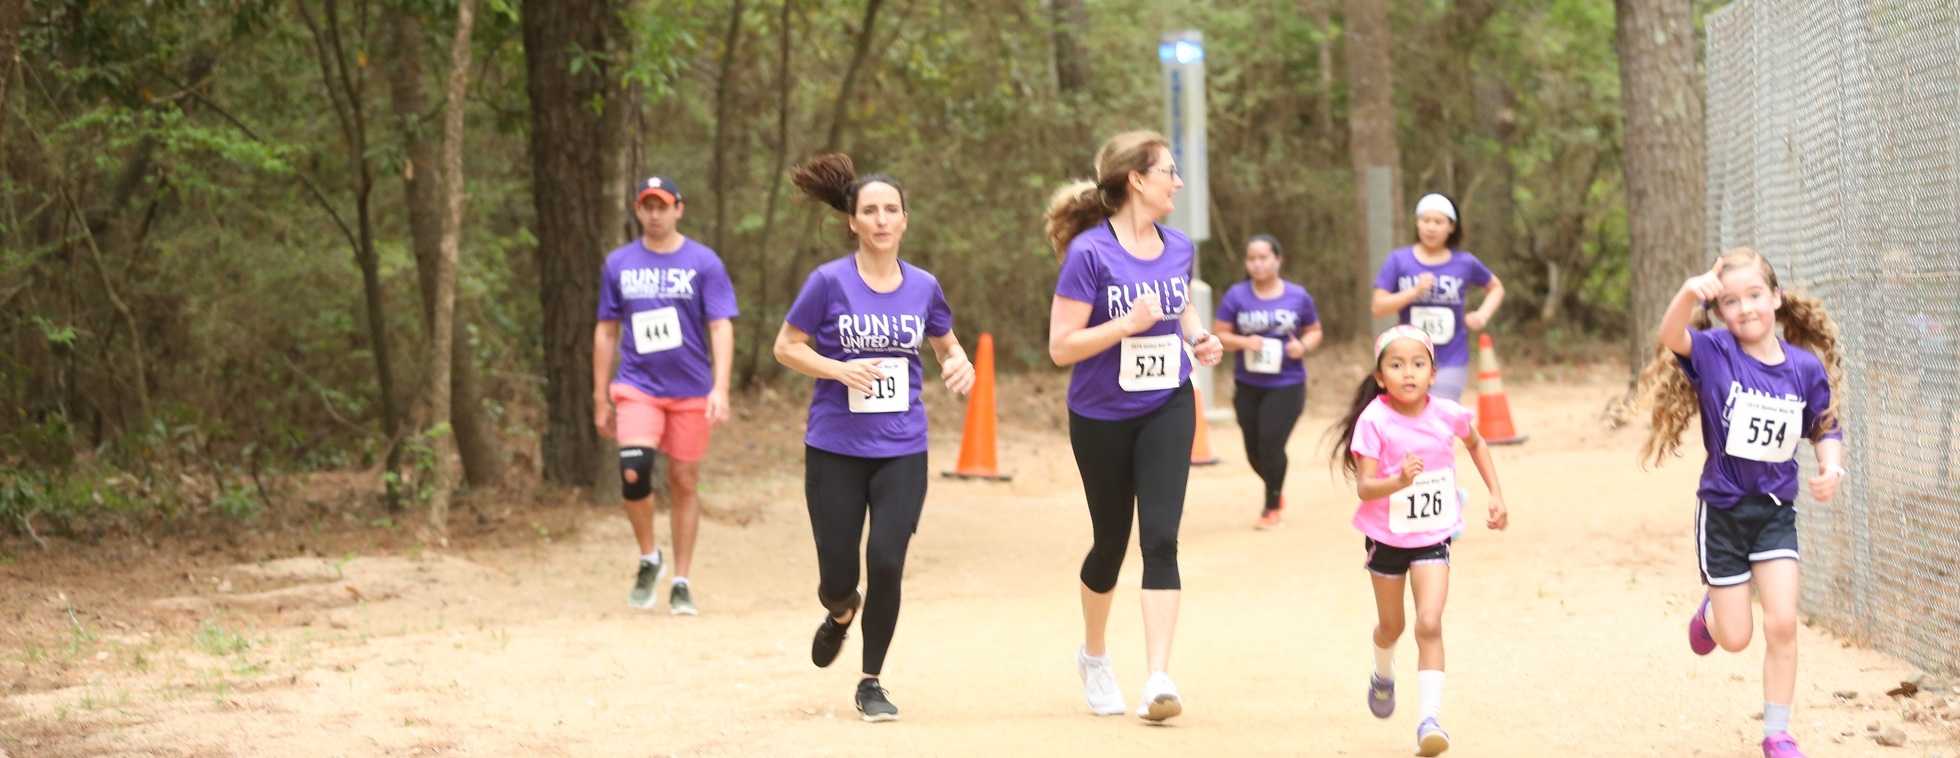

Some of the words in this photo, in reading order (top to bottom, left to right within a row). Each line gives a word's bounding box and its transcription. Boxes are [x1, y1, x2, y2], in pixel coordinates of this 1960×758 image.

[667, 267, 697, 294] 5K
[645, 322, 669, 341] 444
[838, 313, 890, 337] RUN
[840, 334, 890, 349] UNITED
[1135, 355, 1165, 379] 521
[1746, 416, 1787, 449] 554
[1406, 490, 1443, 519] 126
